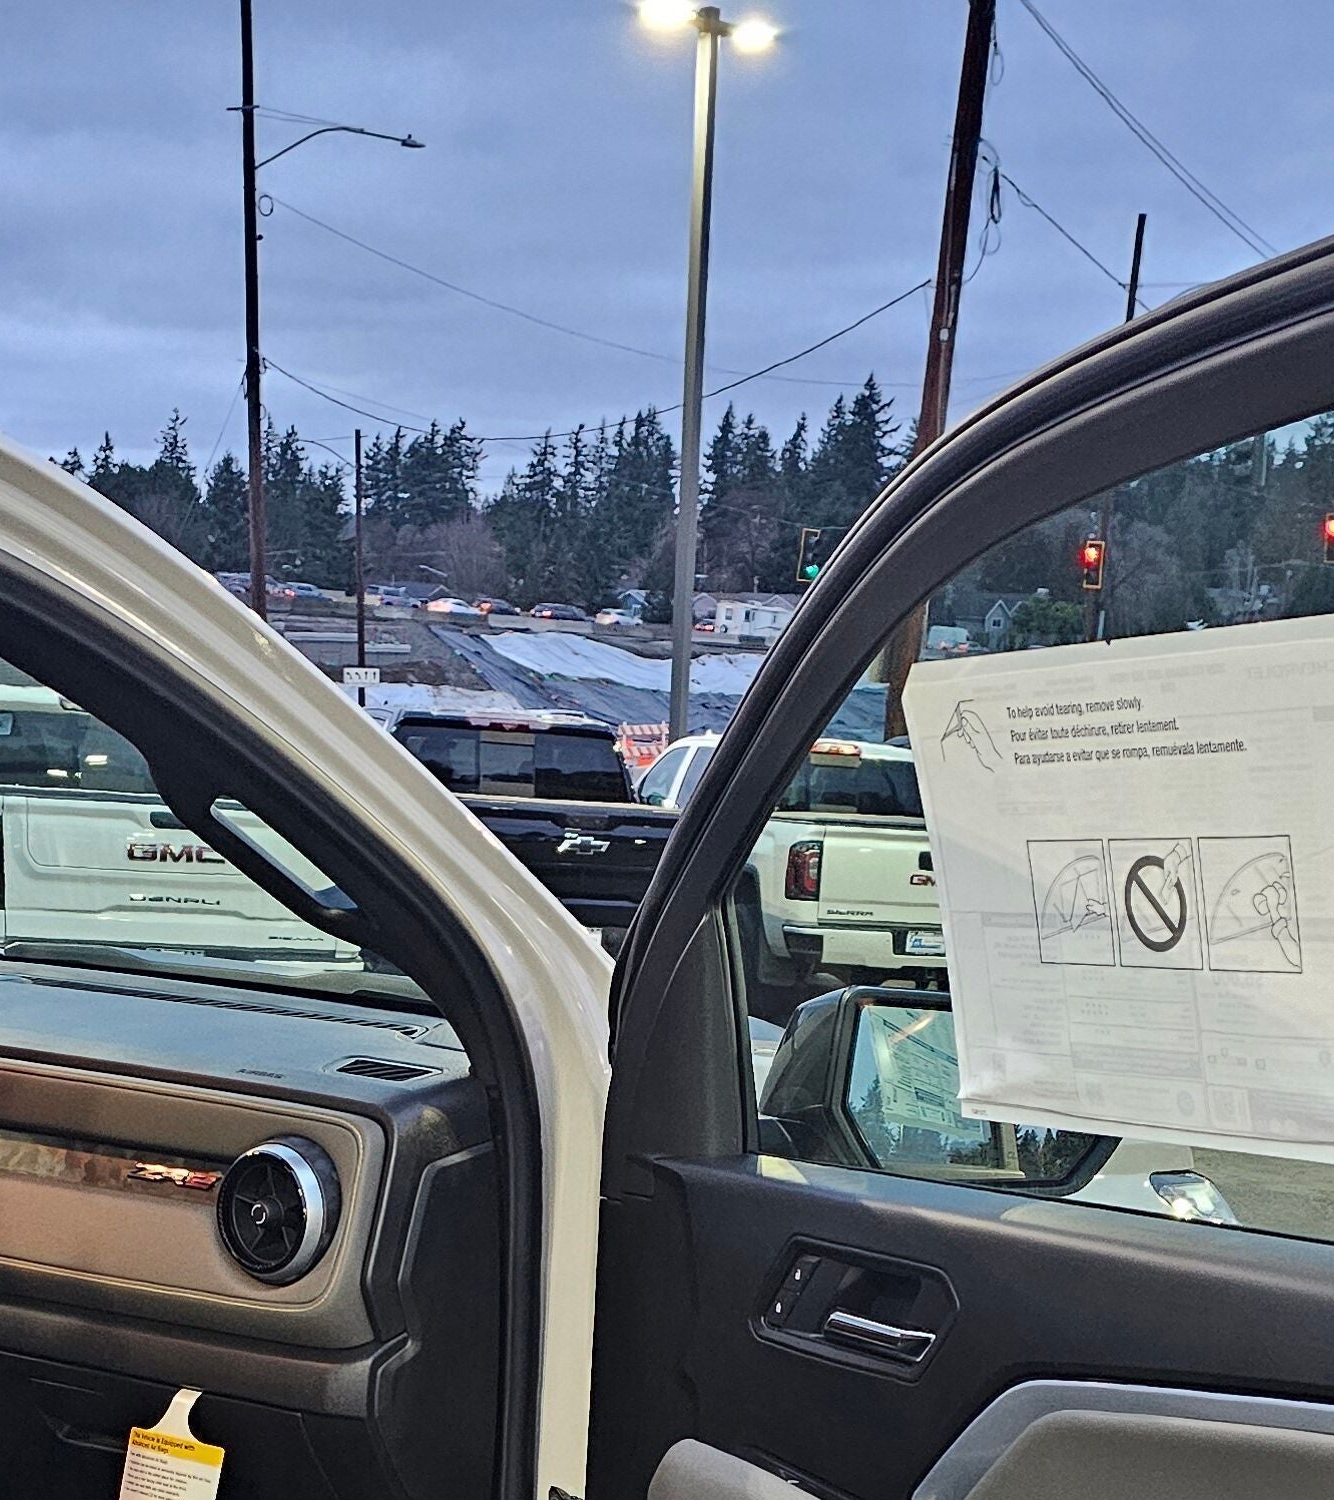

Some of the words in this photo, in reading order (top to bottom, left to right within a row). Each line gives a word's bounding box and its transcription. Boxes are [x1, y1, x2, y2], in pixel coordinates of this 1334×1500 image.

[1006, 706, 1017, 719] To
[1017, 705, 1034, 720] help
[1035, 703, 1055, 717] avoid
[1056, 700, 1085, 716] tearing,
[1085, 699, 1115, 713] remove
[1116, 696, 1145, 711] slowly.
[1010, 729, 1027, 742] Pour
[1050, 725, 1070, 739] toute
[1110, 721, 1135, 735] retirer
[1014, 752, 1031, 765] Para
[1066, 752, 1072, 762] a
[1072, 748, 1094, 761] evitar
[1095, 748, 1110, 762] que
[1111, 748, 1121, 759] se
[1122, 745, 1151, 760] rompa,
[1196, 739, 1248, 754] lentamente.
[127, 842, 226, 864] GMC
[129, 893, 221, 906] DENALI
